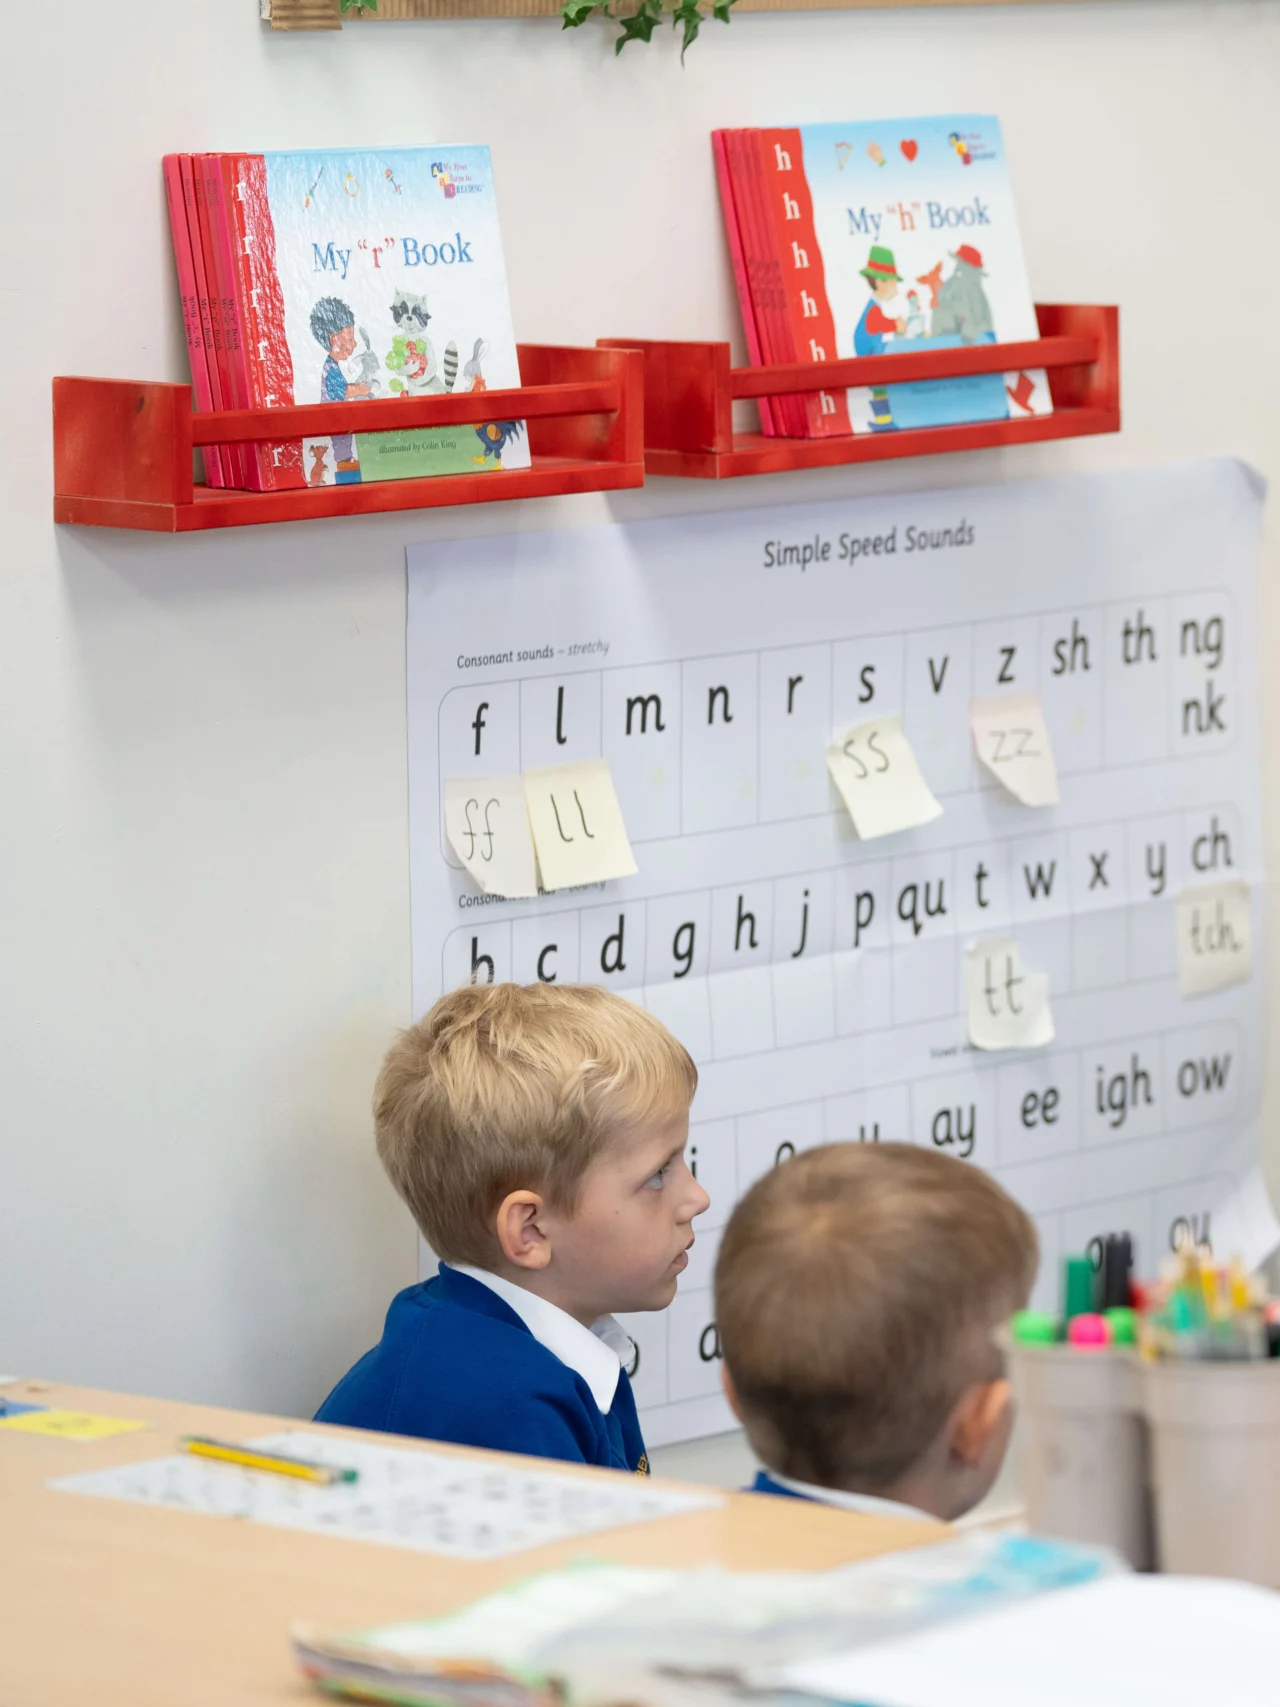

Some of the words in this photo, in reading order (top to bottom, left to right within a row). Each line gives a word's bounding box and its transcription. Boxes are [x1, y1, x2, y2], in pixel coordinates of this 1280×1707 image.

[774, 143, 792, 171] h
[782, 192, 801, 220] h
[846, 206, 882, 242] My
[926, 196, 991, 229] Book
[311, 241, 351, 281] My
[400, 232, 474, 267] Book
[791, 241, 810, 269] h
[800, 290, 818, 318] h
[819, 390, 837, 415] h
[412, 442, 421, 453] by
[764, 534, 831, 572] Simple
[838, 526, 897, 566] Speed
[904, 518, 975, 552] Sounds
[457, 652, 514, 669] Consonant
[517, 644, 554, 662] sounds
[568, 639, 610, 657] stretchy
[472, 702, 489, 756] f
[555, 686, 567, 745] l
[625, 693, 666, 736] m
[707, 684, 733, 725] n
[787, 674, 804, 715] r
[858, 664, 875, 704] s
[928, 656, 950, 695] v
[997, 646, 1017, 685] z
[1051, 618, 1091, 677] sh
[1121, 609, 1157, 666] th
[1180, 615, 1224, 670] ng
[1182, 680, 1226, 736] nk
[462, 798, 500, 862] ff
[537, 944, 558, 983] c
[600, 914, 626, 974] d
[672, 921, 696, 979] g
[735, 894, 759, 951] h
[791, 889, 810, 958] j
[854, 890, 876, 948] p
[897, 878, 947, 937] qu
[975, 861, 990, 908] t
[1023, 860, 1057, 900] w
[1088, 850, 1110, 891] x
[1145, 842, 1166, 895] y
[1191, 815, 1234, 872] ch
[932, 1103, 975, 1158] ay
[1020, 1085, 1060, 1129] ee
[1095, 1053, 1153, 1129] igh
[1177, 1053, 1233, 1097] ow
